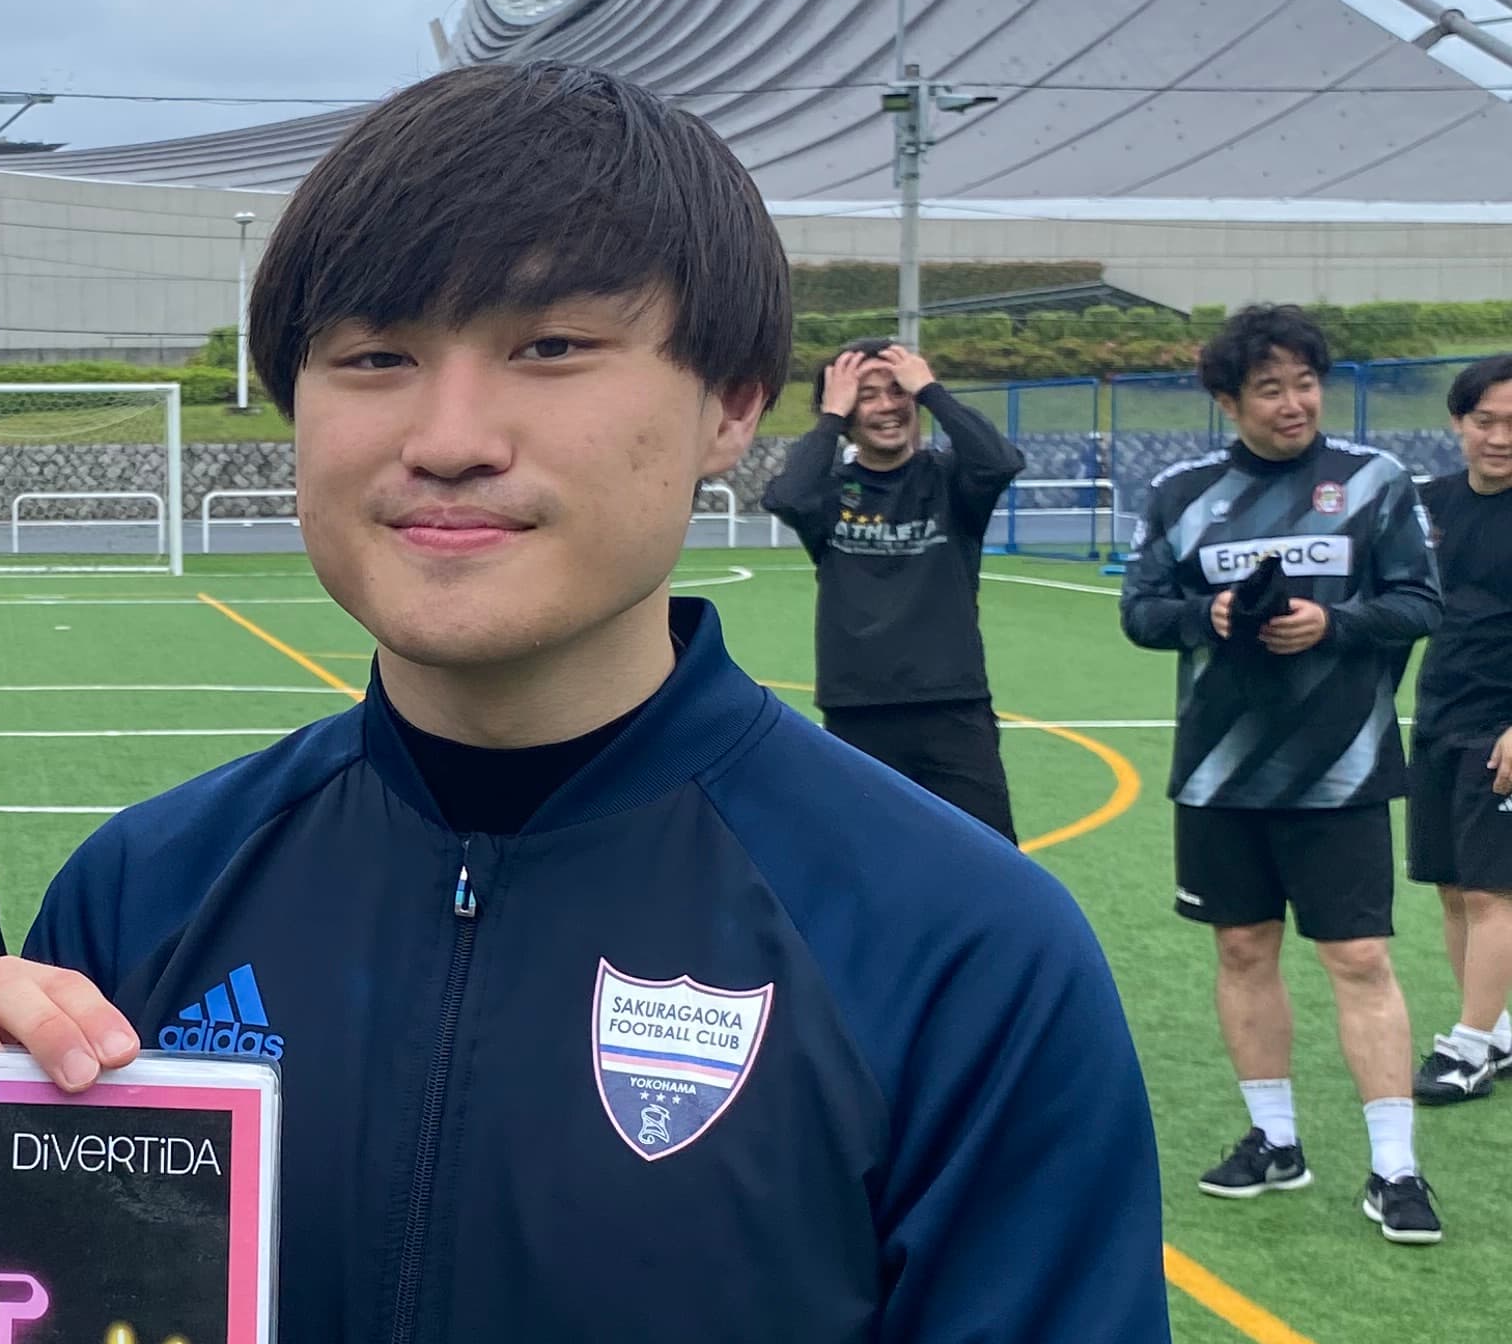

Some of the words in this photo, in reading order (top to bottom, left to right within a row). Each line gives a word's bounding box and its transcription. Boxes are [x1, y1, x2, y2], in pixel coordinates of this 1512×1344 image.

[611, 996, 743, 1030] SAKURAGAOKA
[158, 1019, 285, 1062] adidas
[608, 1018, 691, 1042] FOOTBALL
[696, 1029, 740, 1050] CLUB
[629, 1076, 697, 1095] YOKOHAMA
